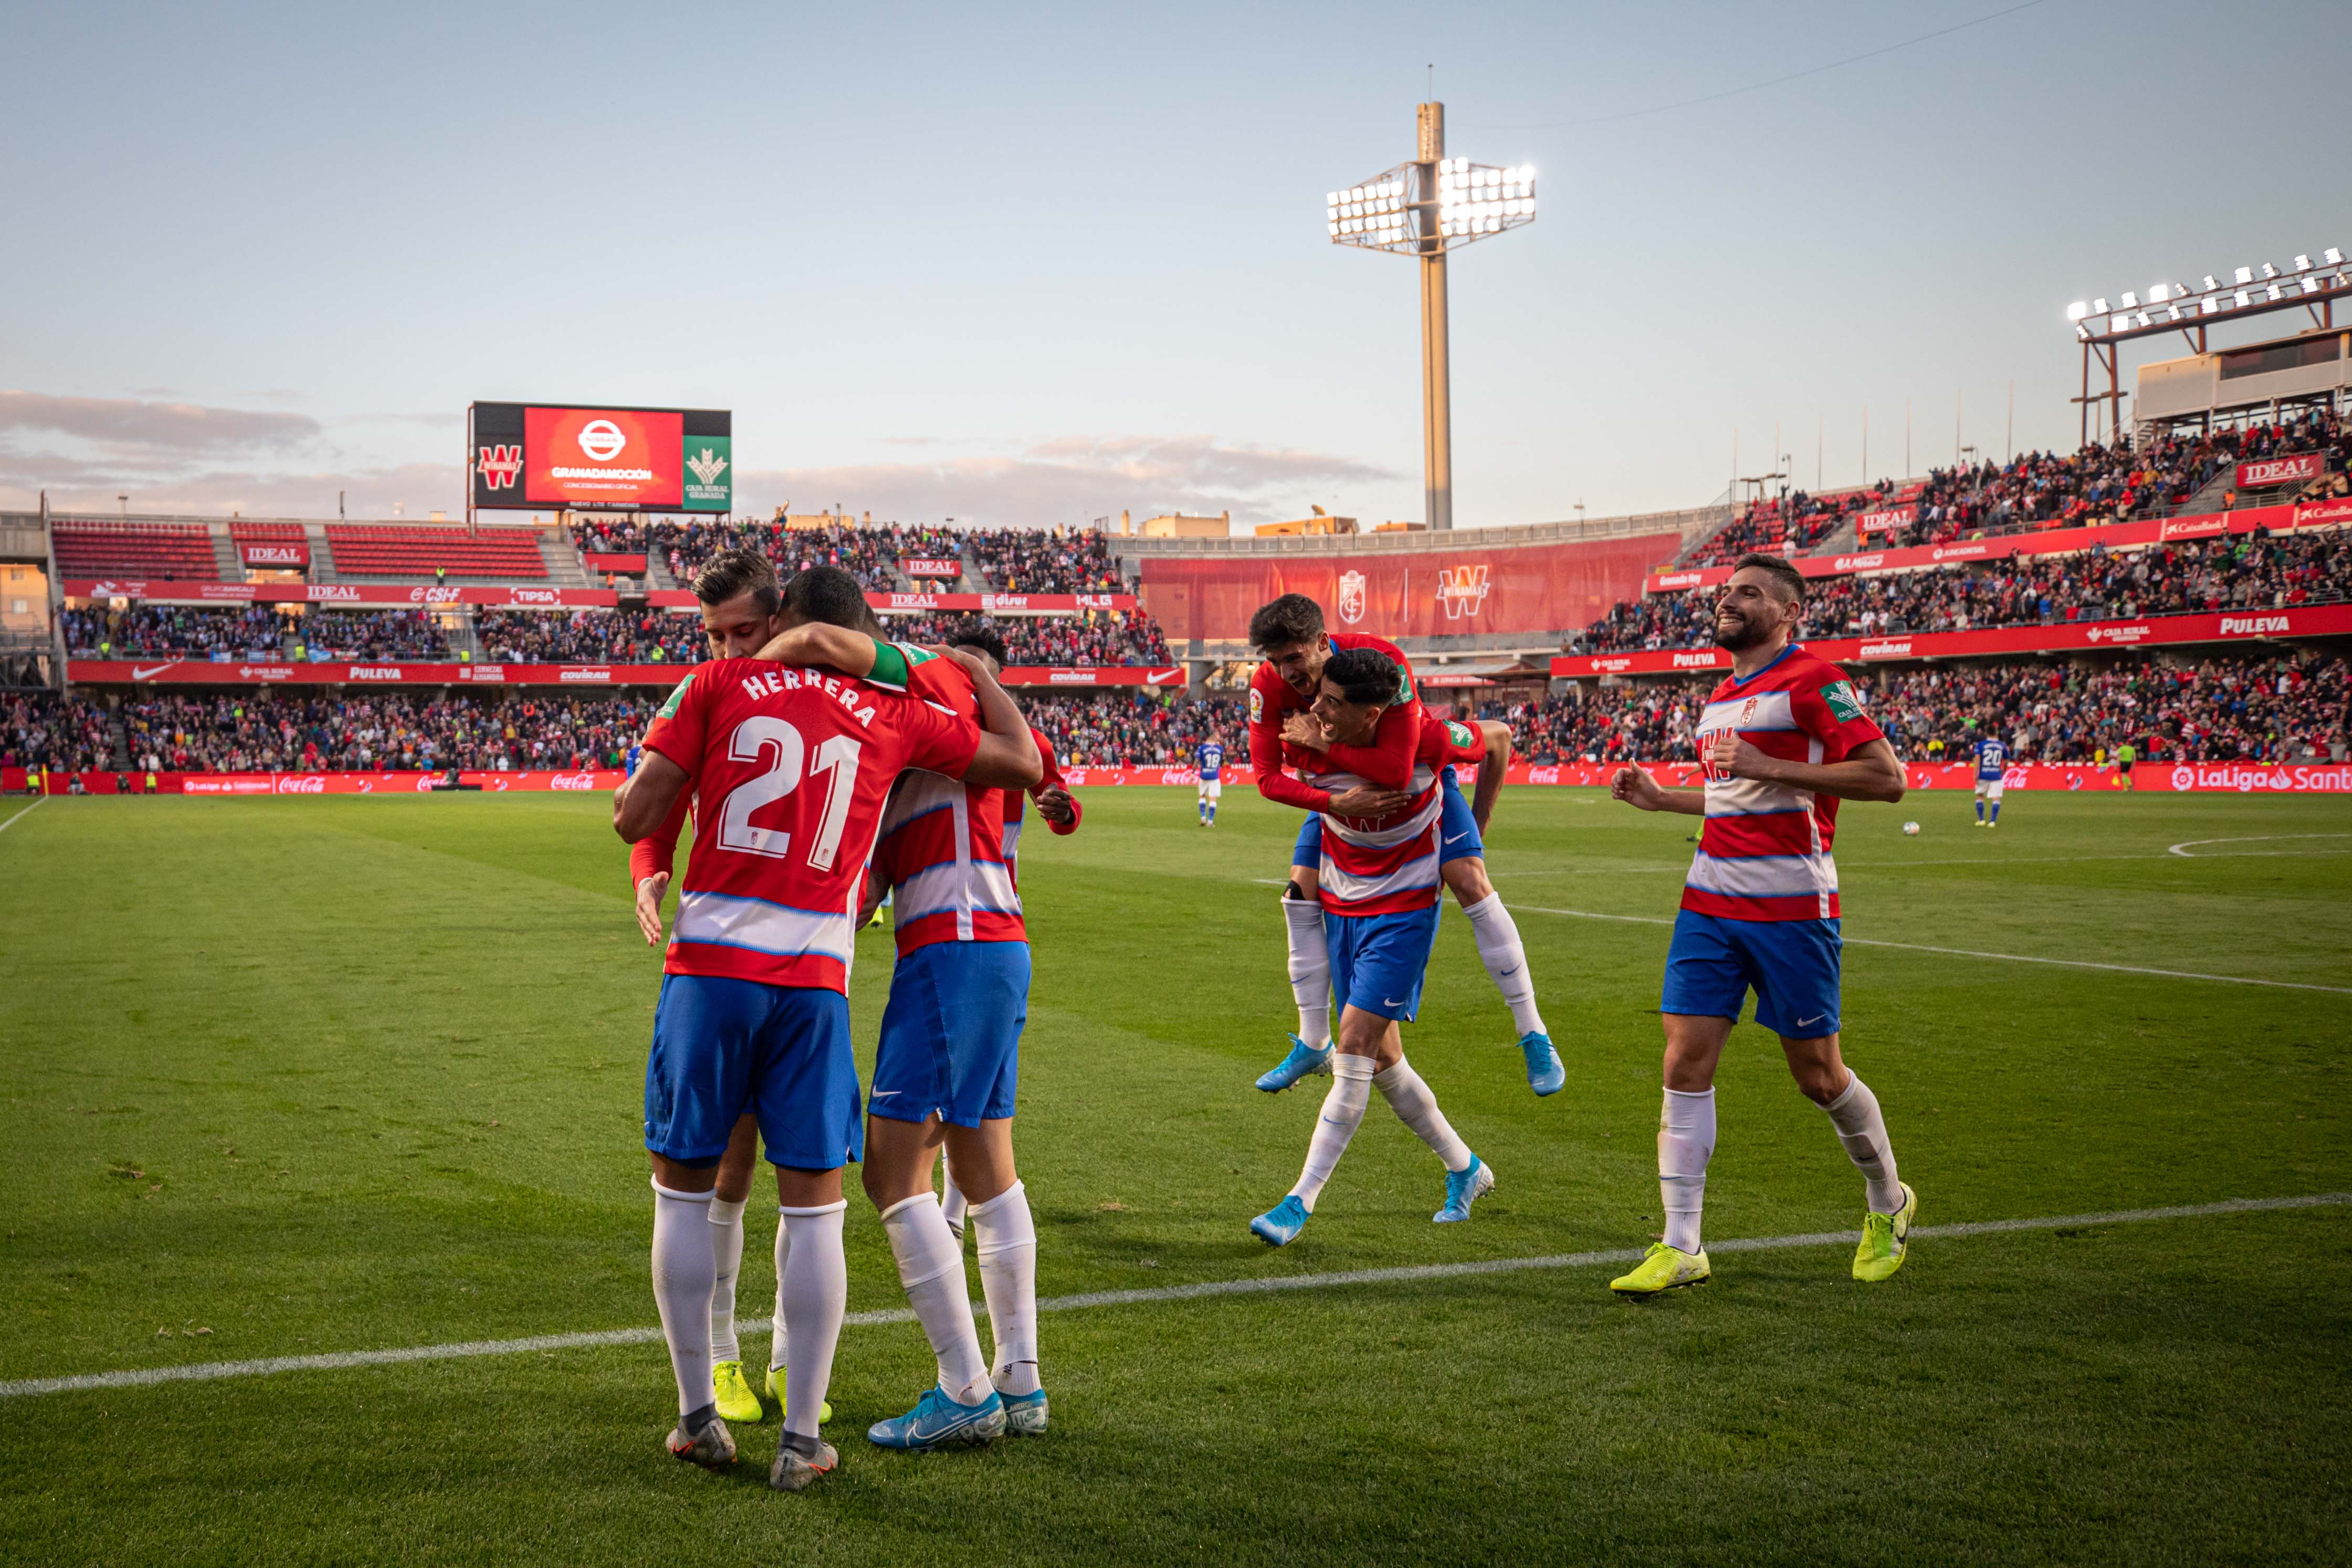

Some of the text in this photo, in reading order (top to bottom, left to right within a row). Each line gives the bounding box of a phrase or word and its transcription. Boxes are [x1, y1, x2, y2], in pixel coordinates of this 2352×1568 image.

[484, 461, 517, 471] WINAMAX
[2245, 459, 2314, 481] IDEAL
[1864, 510, 1912, 526] IDEAL
[248, 548, 300, 560] IDEAL
[909, 560, 954, 572] IDEAL
[307, 585, 360, 598] IDEAL
[518, 591, 554, 602] TIPSA
[1443, 585, 1481, 597] WINAMAX
[891, 594, 938, 605] IDEAL
[996, 594, 1027, 605] disur
[2220, 616, 2290, 634] PULEVA
[1673, 653, 1716, 667] PULEVA
[349, 666, 402, 679] PULEVA
[741, 668, 876, 728] HERRERA
[1205, 753, 1221, 767] 18
[1982, 749, 2002, 766] 20
[2198, 766, 2269, 792] LaLiga
[717, 715, 862, 872] 21
